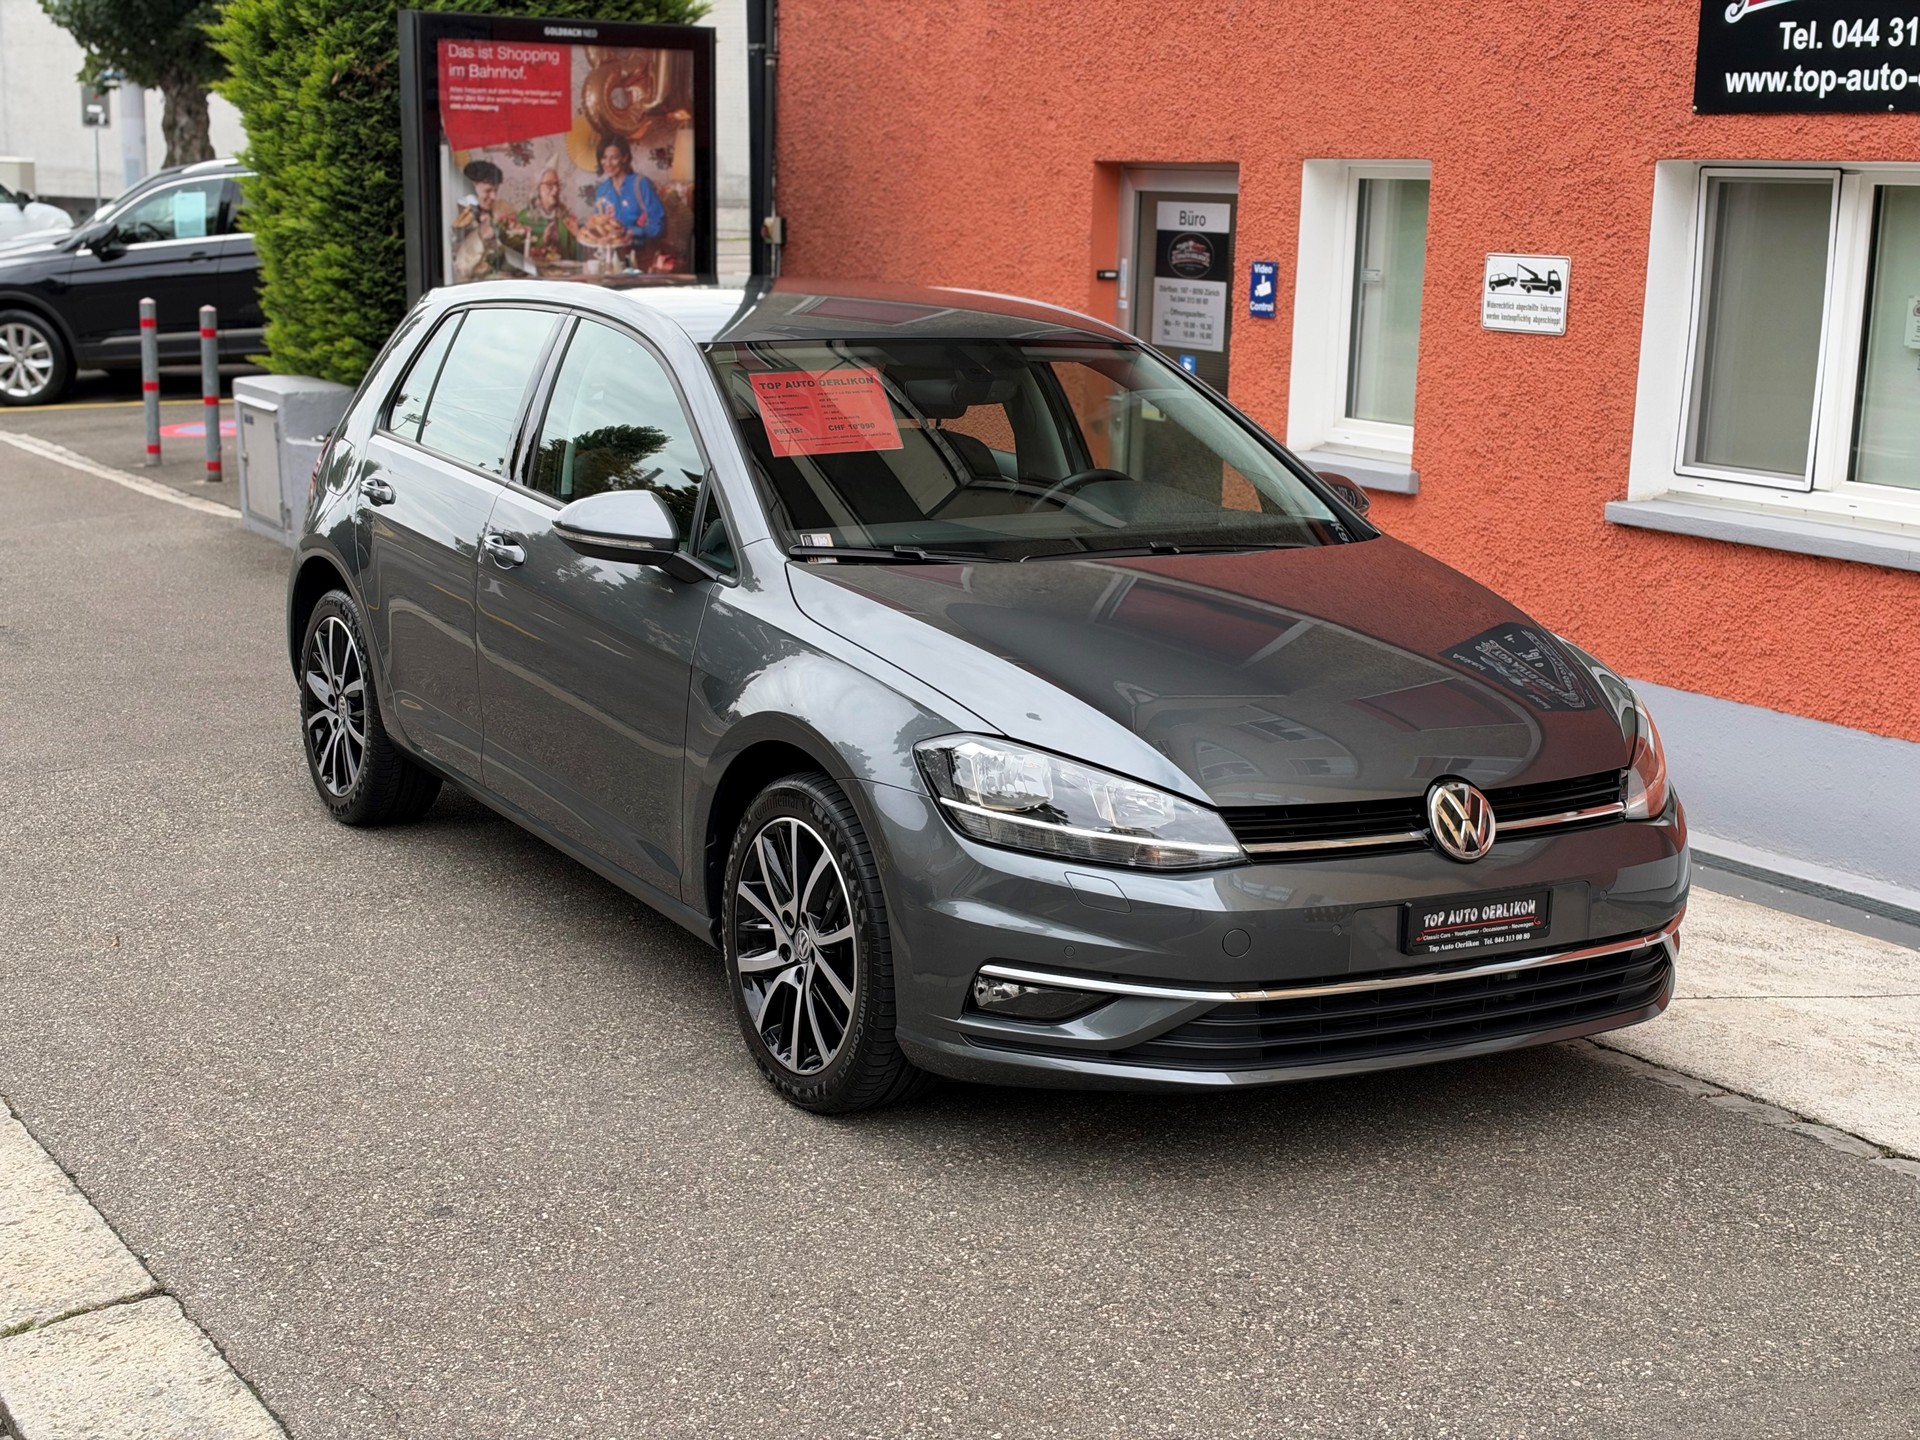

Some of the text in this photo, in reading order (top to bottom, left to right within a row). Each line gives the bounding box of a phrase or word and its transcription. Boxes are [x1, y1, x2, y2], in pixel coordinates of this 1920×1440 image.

[544, 27, 582, 38] GOLDBACH
[1779, 21, 1823, 50] Tel.
[1832, 18, 1880, 49] 044
[448, 44, 560, 65] Das ist Shopping
[448, 63, 527, 80] im Bahnhof.
[1725, 62, 1920, 99] www.top-auto-
[1179, 210, 1206, 227] Büro
[1254, 264, 1273, 274] Video
[1250, 301, 1274, 312] Control
[759, 377, 874, 390] TOP AUTO OERLIKON
[828, 424, 845, 432] CHF
[1424, 899, 1536, 927] TOP AUTO OERLIKON
[1429, 945, 1439, 953] Top
[1440, 943, 1454, 951] Auto
[1455, 940, 1479, 949] Oerlikon
